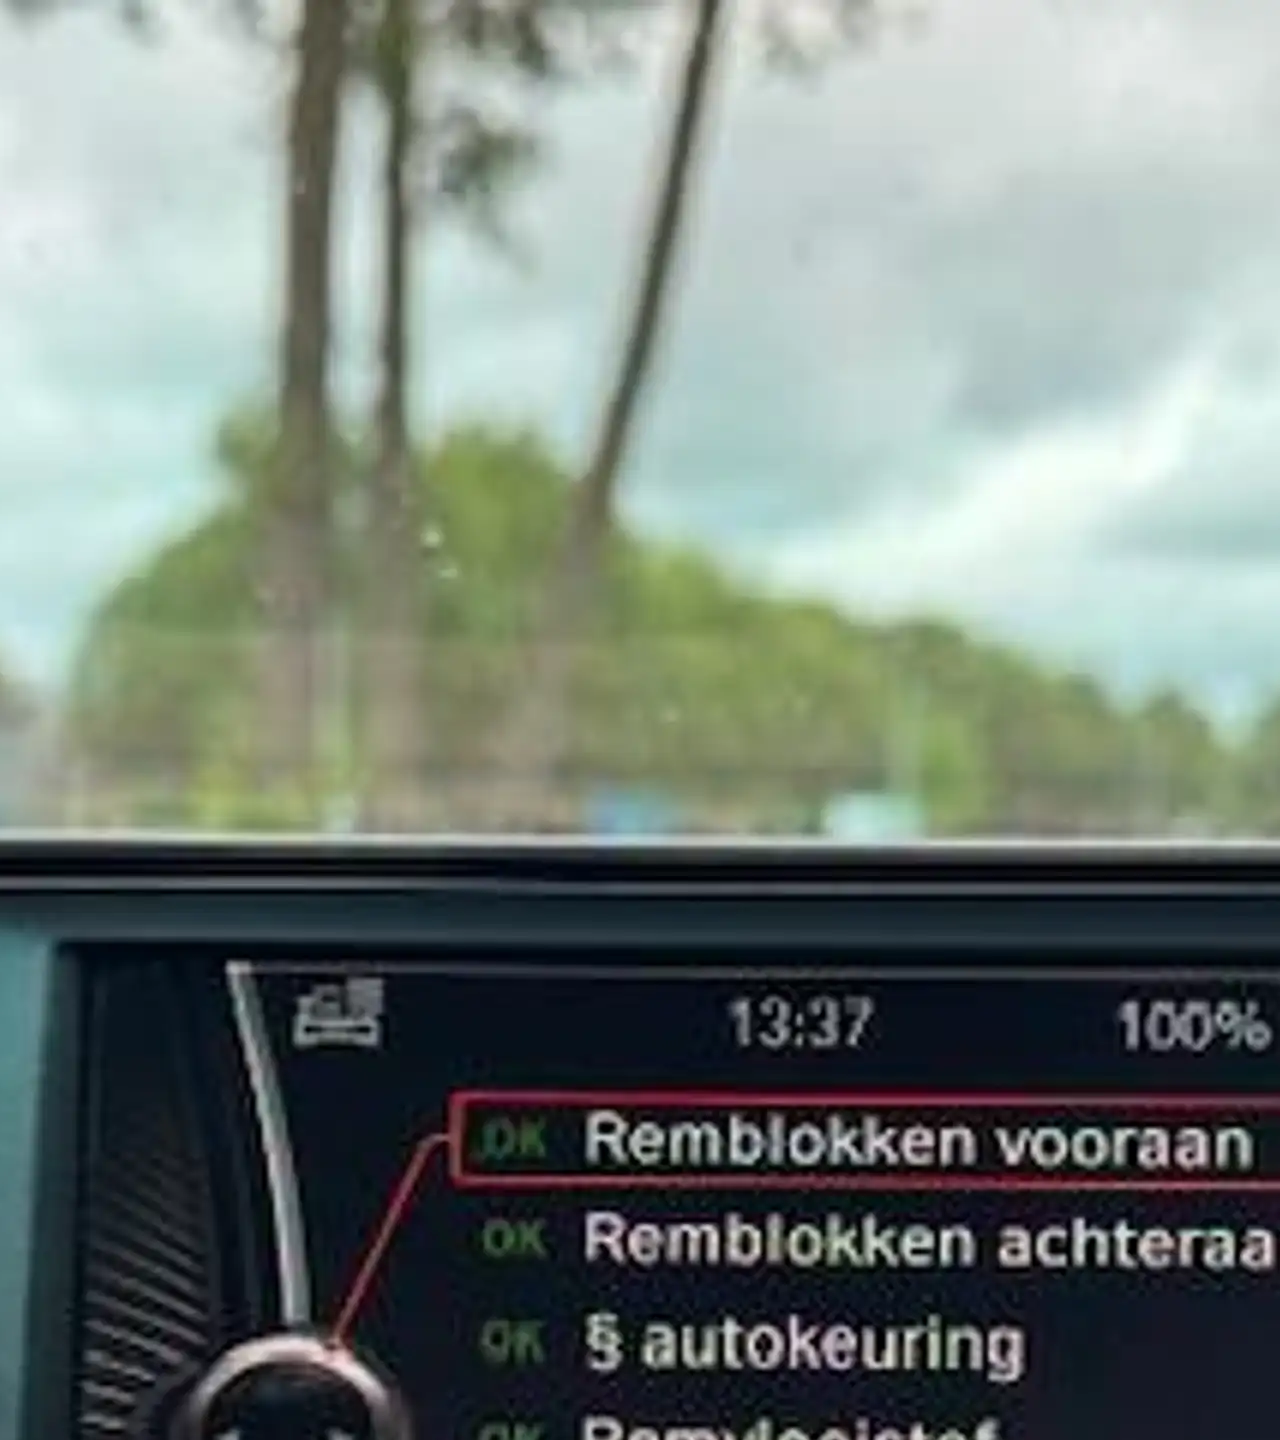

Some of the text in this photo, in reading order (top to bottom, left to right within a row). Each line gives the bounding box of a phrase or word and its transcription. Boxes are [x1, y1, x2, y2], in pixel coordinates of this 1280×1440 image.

[732, 996, 873, 1048] 13:37
[1120, 1000, 1272, 1052] 100%
[481, 1109, 1253, 1171] OK Remblokken vooraan
[481, 1216, 547, 1259] OK
[584, 1210, 976, 1268] Remblokken
[480, 1320, 545, 1362] OK
[641, 1313, 1024, 1384] autokeuring
